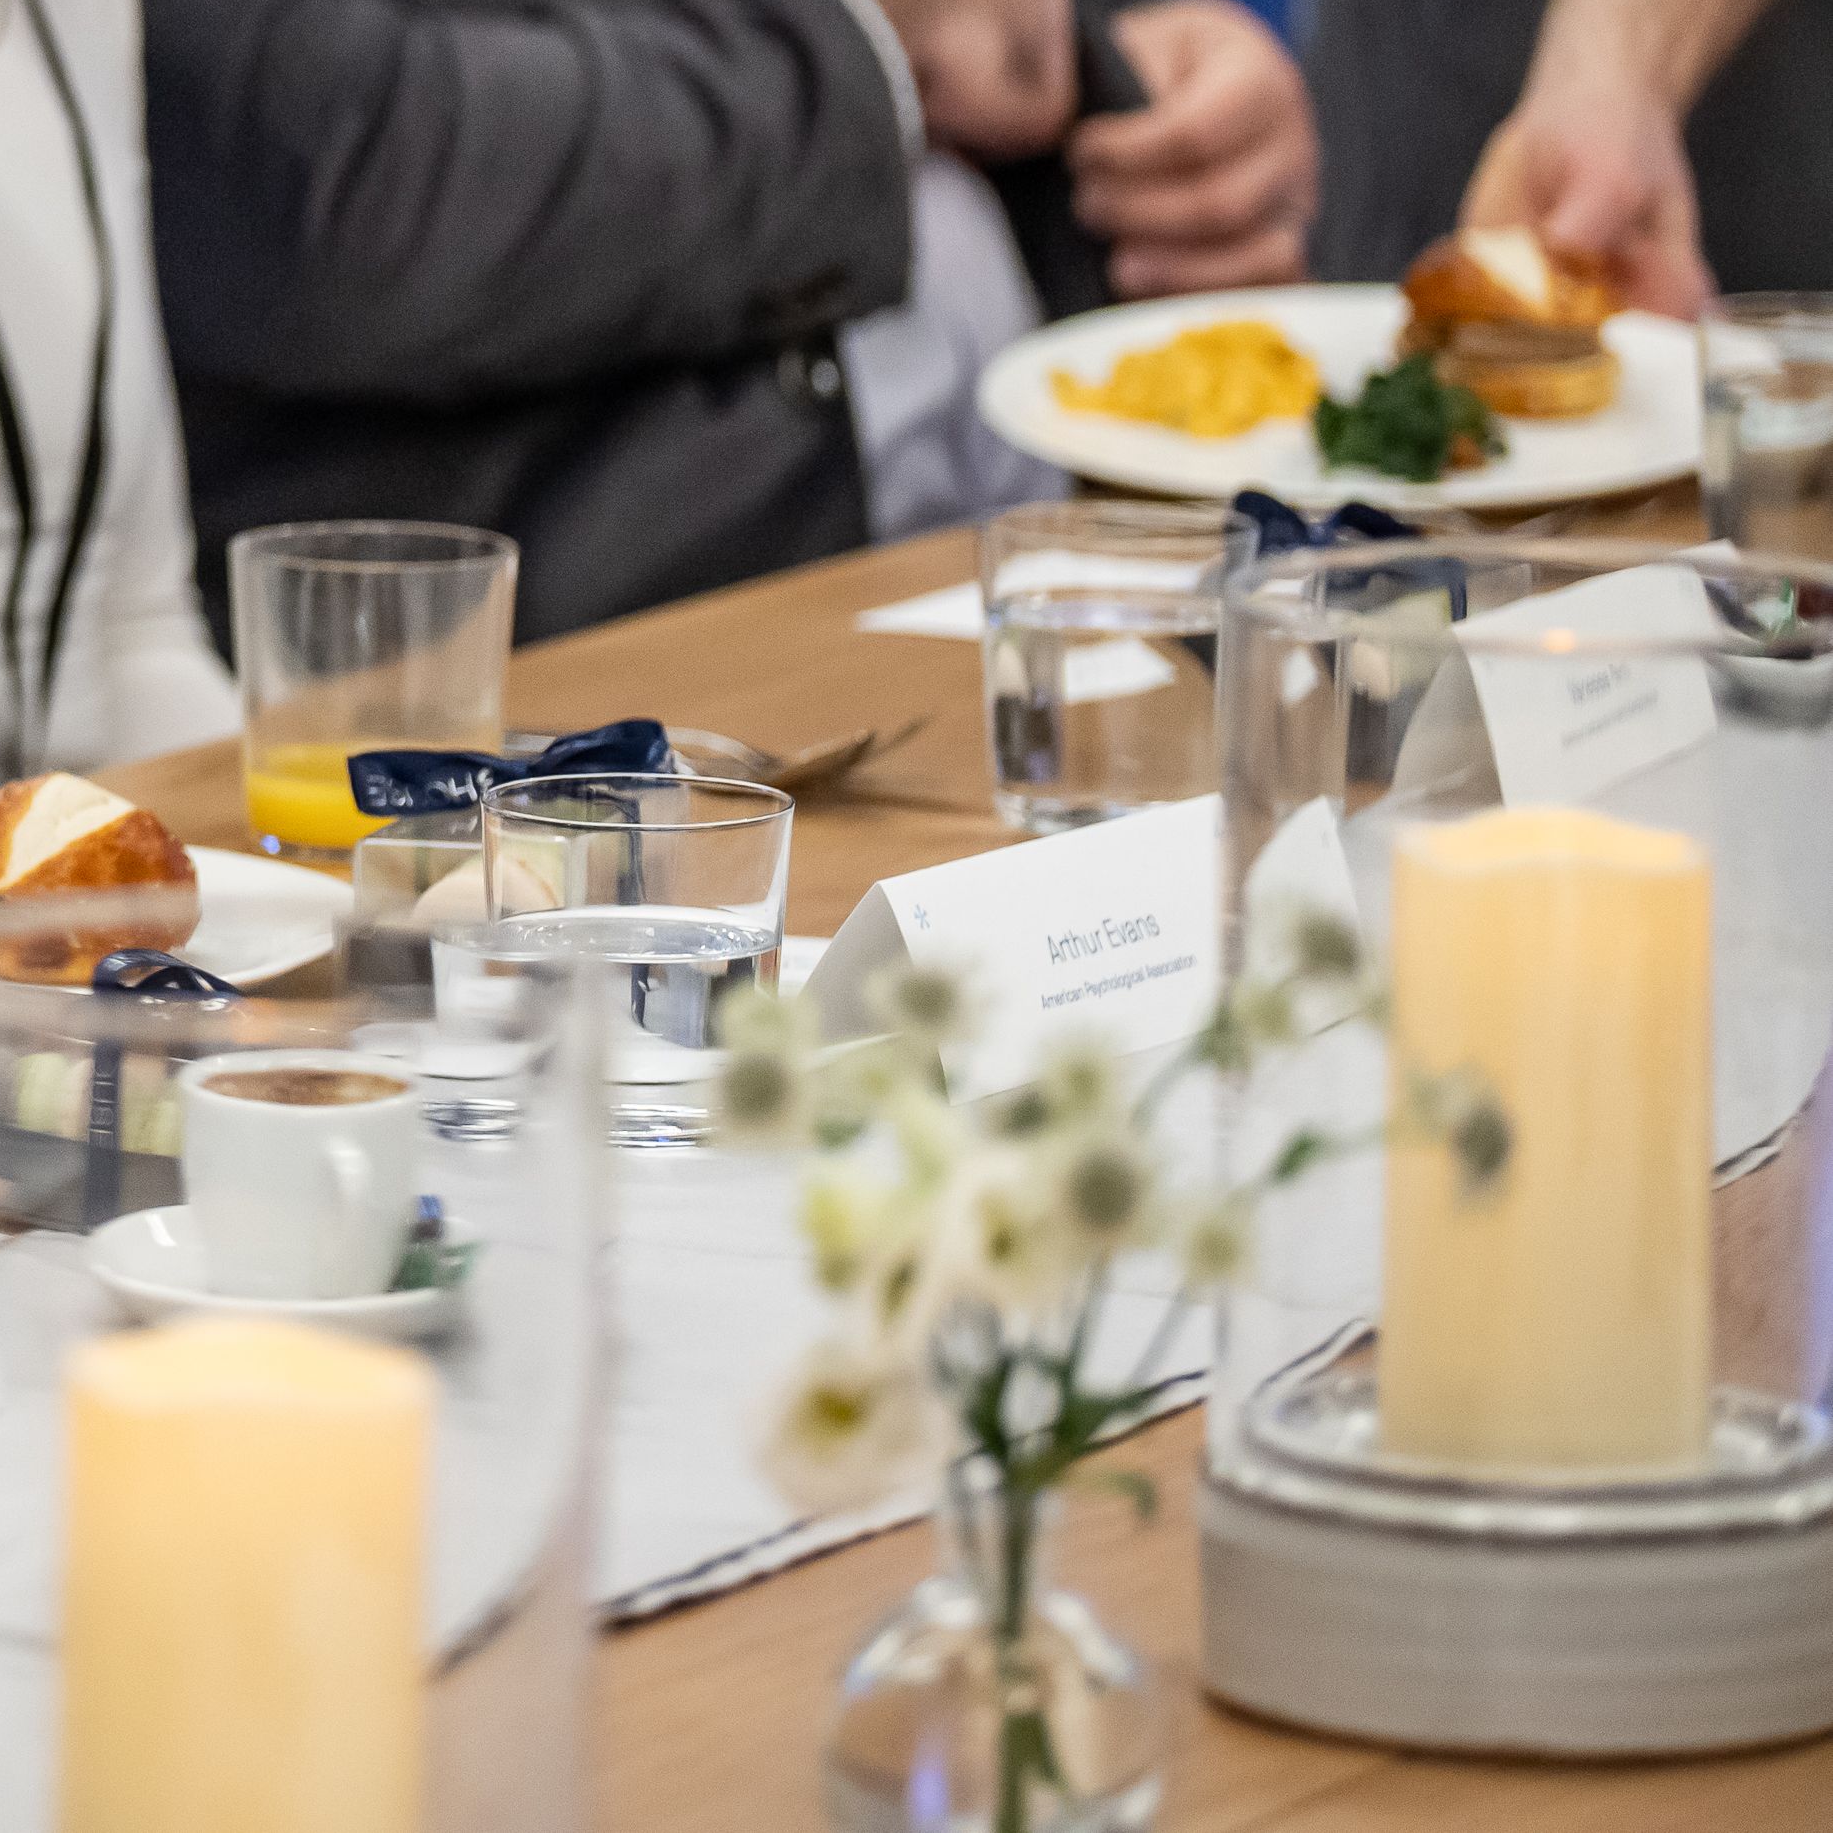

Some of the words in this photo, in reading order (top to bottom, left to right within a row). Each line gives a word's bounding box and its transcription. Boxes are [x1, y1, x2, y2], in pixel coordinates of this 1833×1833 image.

[1046, 928, 1105, 966] Arthur
[1101, 912, 1162, 950] Evans
[1040, 982, 1087, 1011] American
[1083, 965, 1146, 1000] Psychological
[1144, 952, 1198, 980] Association
